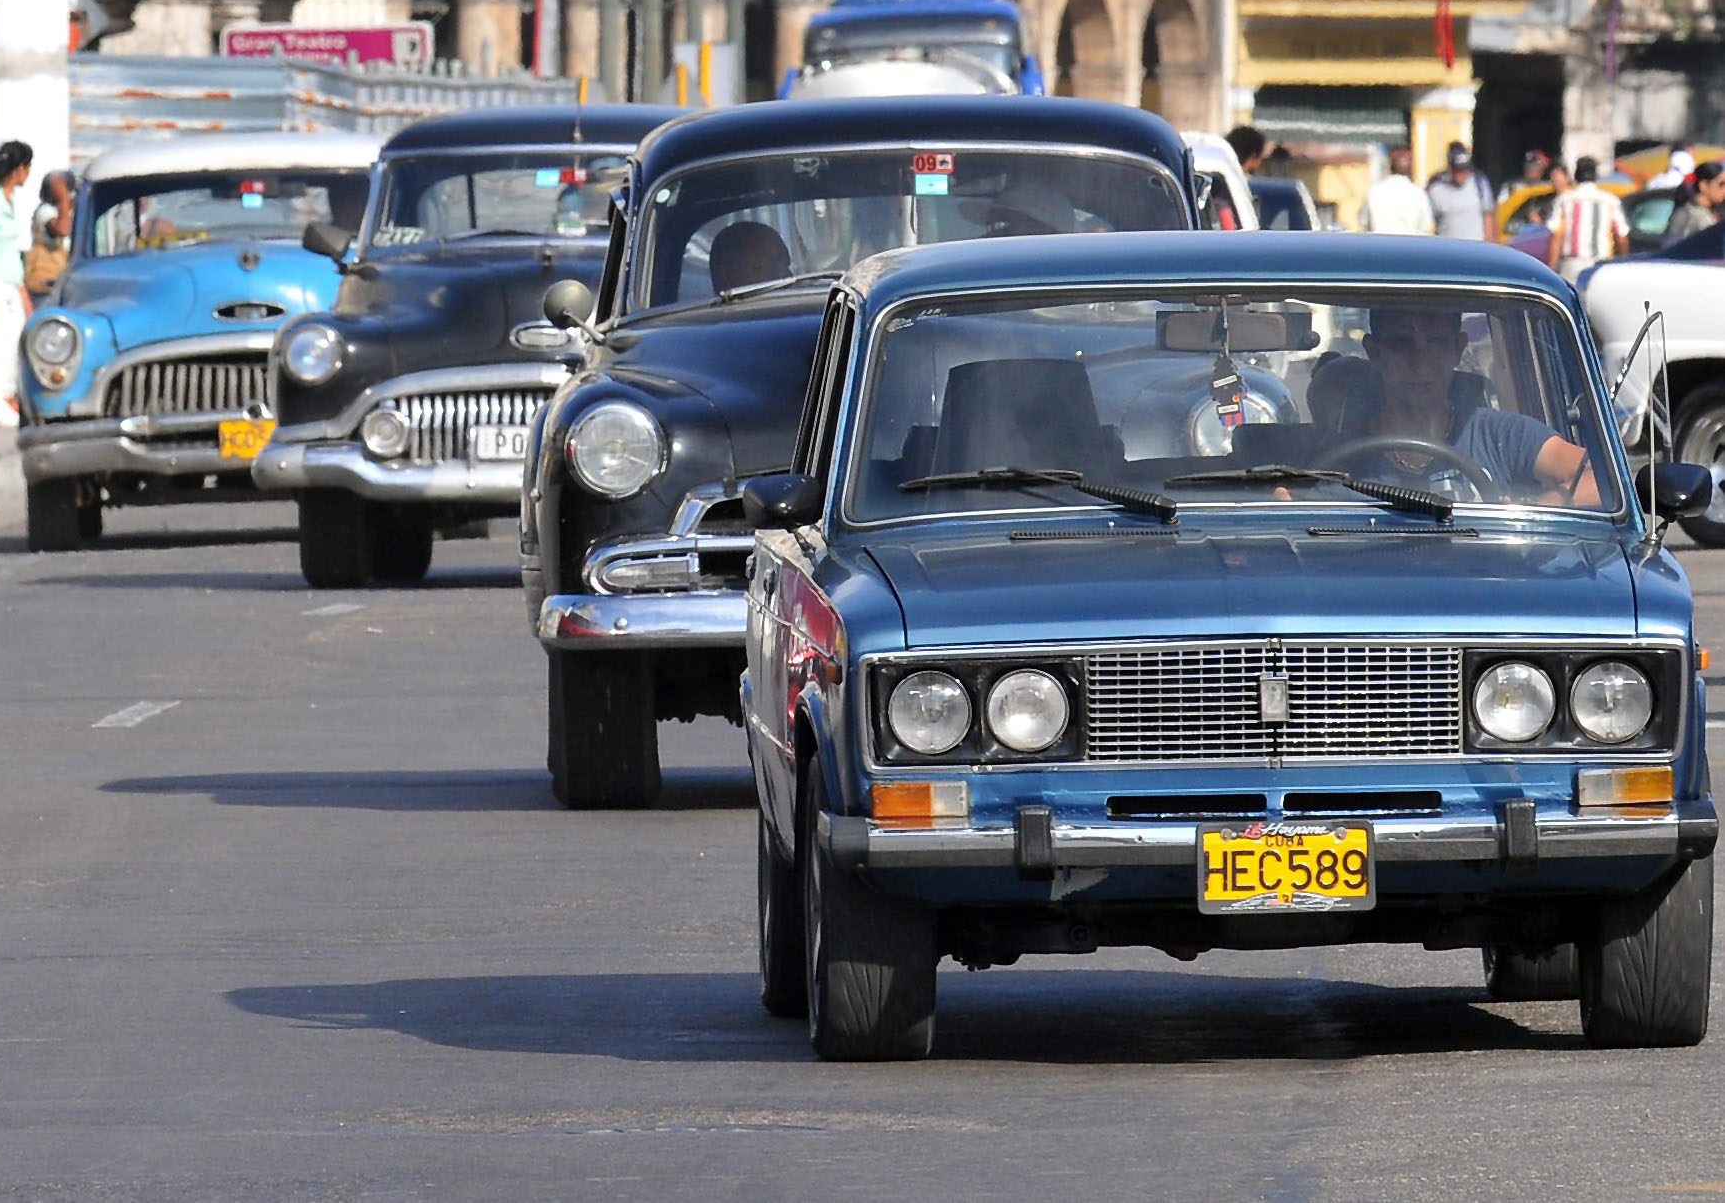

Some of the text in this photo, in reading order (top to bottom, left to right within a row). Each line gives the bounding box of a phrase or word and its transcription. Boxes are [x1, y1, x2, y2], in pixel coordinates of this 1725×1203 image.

[282, 32, 349, 51] Teatro
[915, 155, 937, 172] 09
[1264, 835, 1304, 848] CUBA
